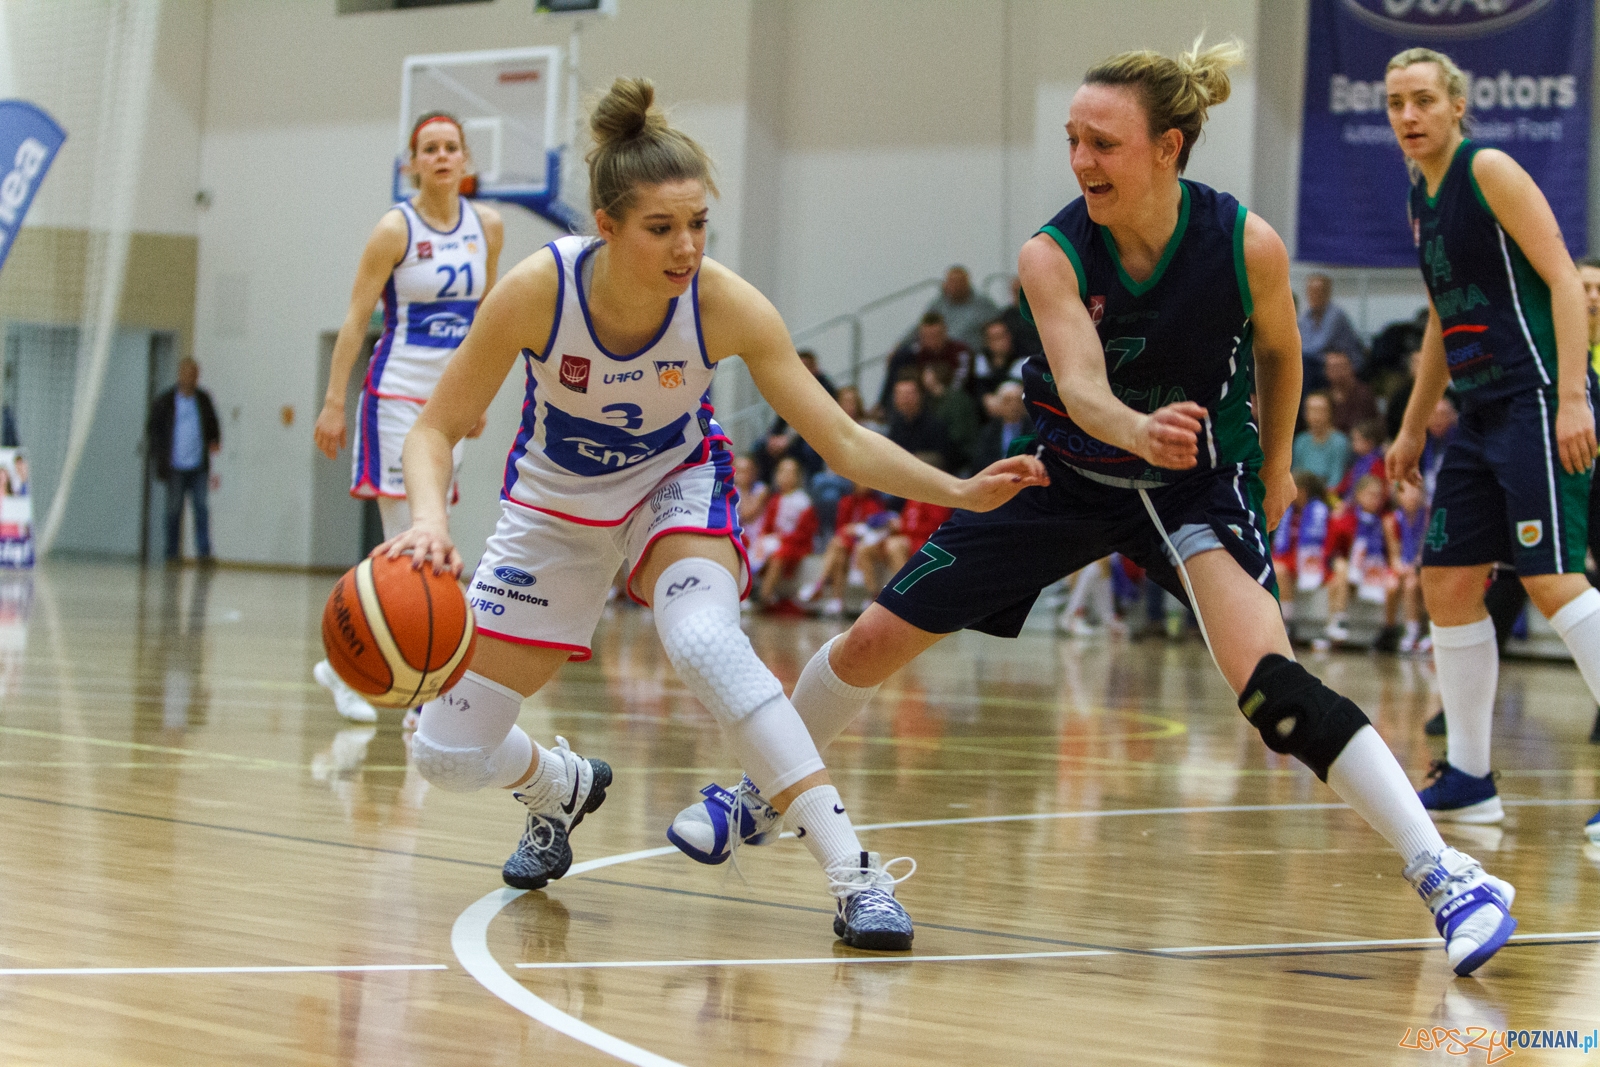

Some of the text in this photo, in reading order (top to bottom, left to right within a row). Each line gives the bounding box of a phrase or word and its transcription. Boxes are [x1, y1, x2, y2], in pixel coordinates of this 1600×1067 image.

[1468, 70, 1577, 110] otors
[436, 262, 473, 298] 21
[428, 319, 470, 338] Ene
[1105, 336, 1147, 374] 7
[601, 402, 644, 430] 3
[500, 569, 528, 584] Ford
[892, 541, 957, 595] 7
[476, 581, 549, 607] Bemo Motors
